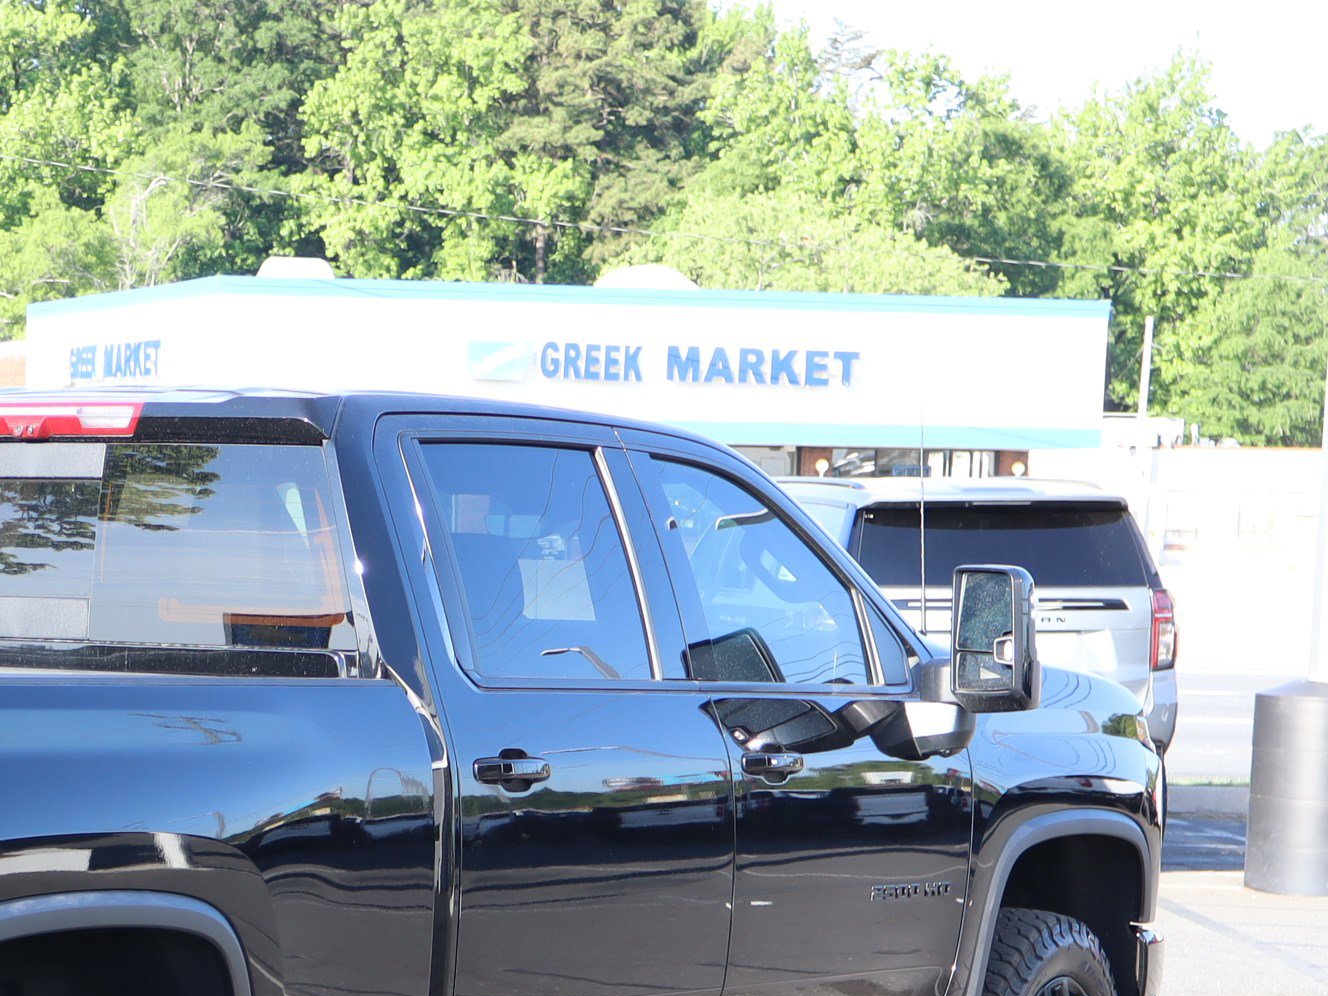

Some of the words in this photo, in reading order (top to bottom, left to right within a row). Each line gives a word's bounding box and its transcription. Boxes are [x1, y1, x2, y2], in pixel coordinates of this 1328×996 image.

[70, 345, 97, 379] GREEK
[103, 340, 160, 378] MARKET
[540, 341, 644, 383] GREEK
[666, 345, 861, 388] MARKET
[870, 883, 920, 901] 2500
[924, 881, 951, 897] HD
